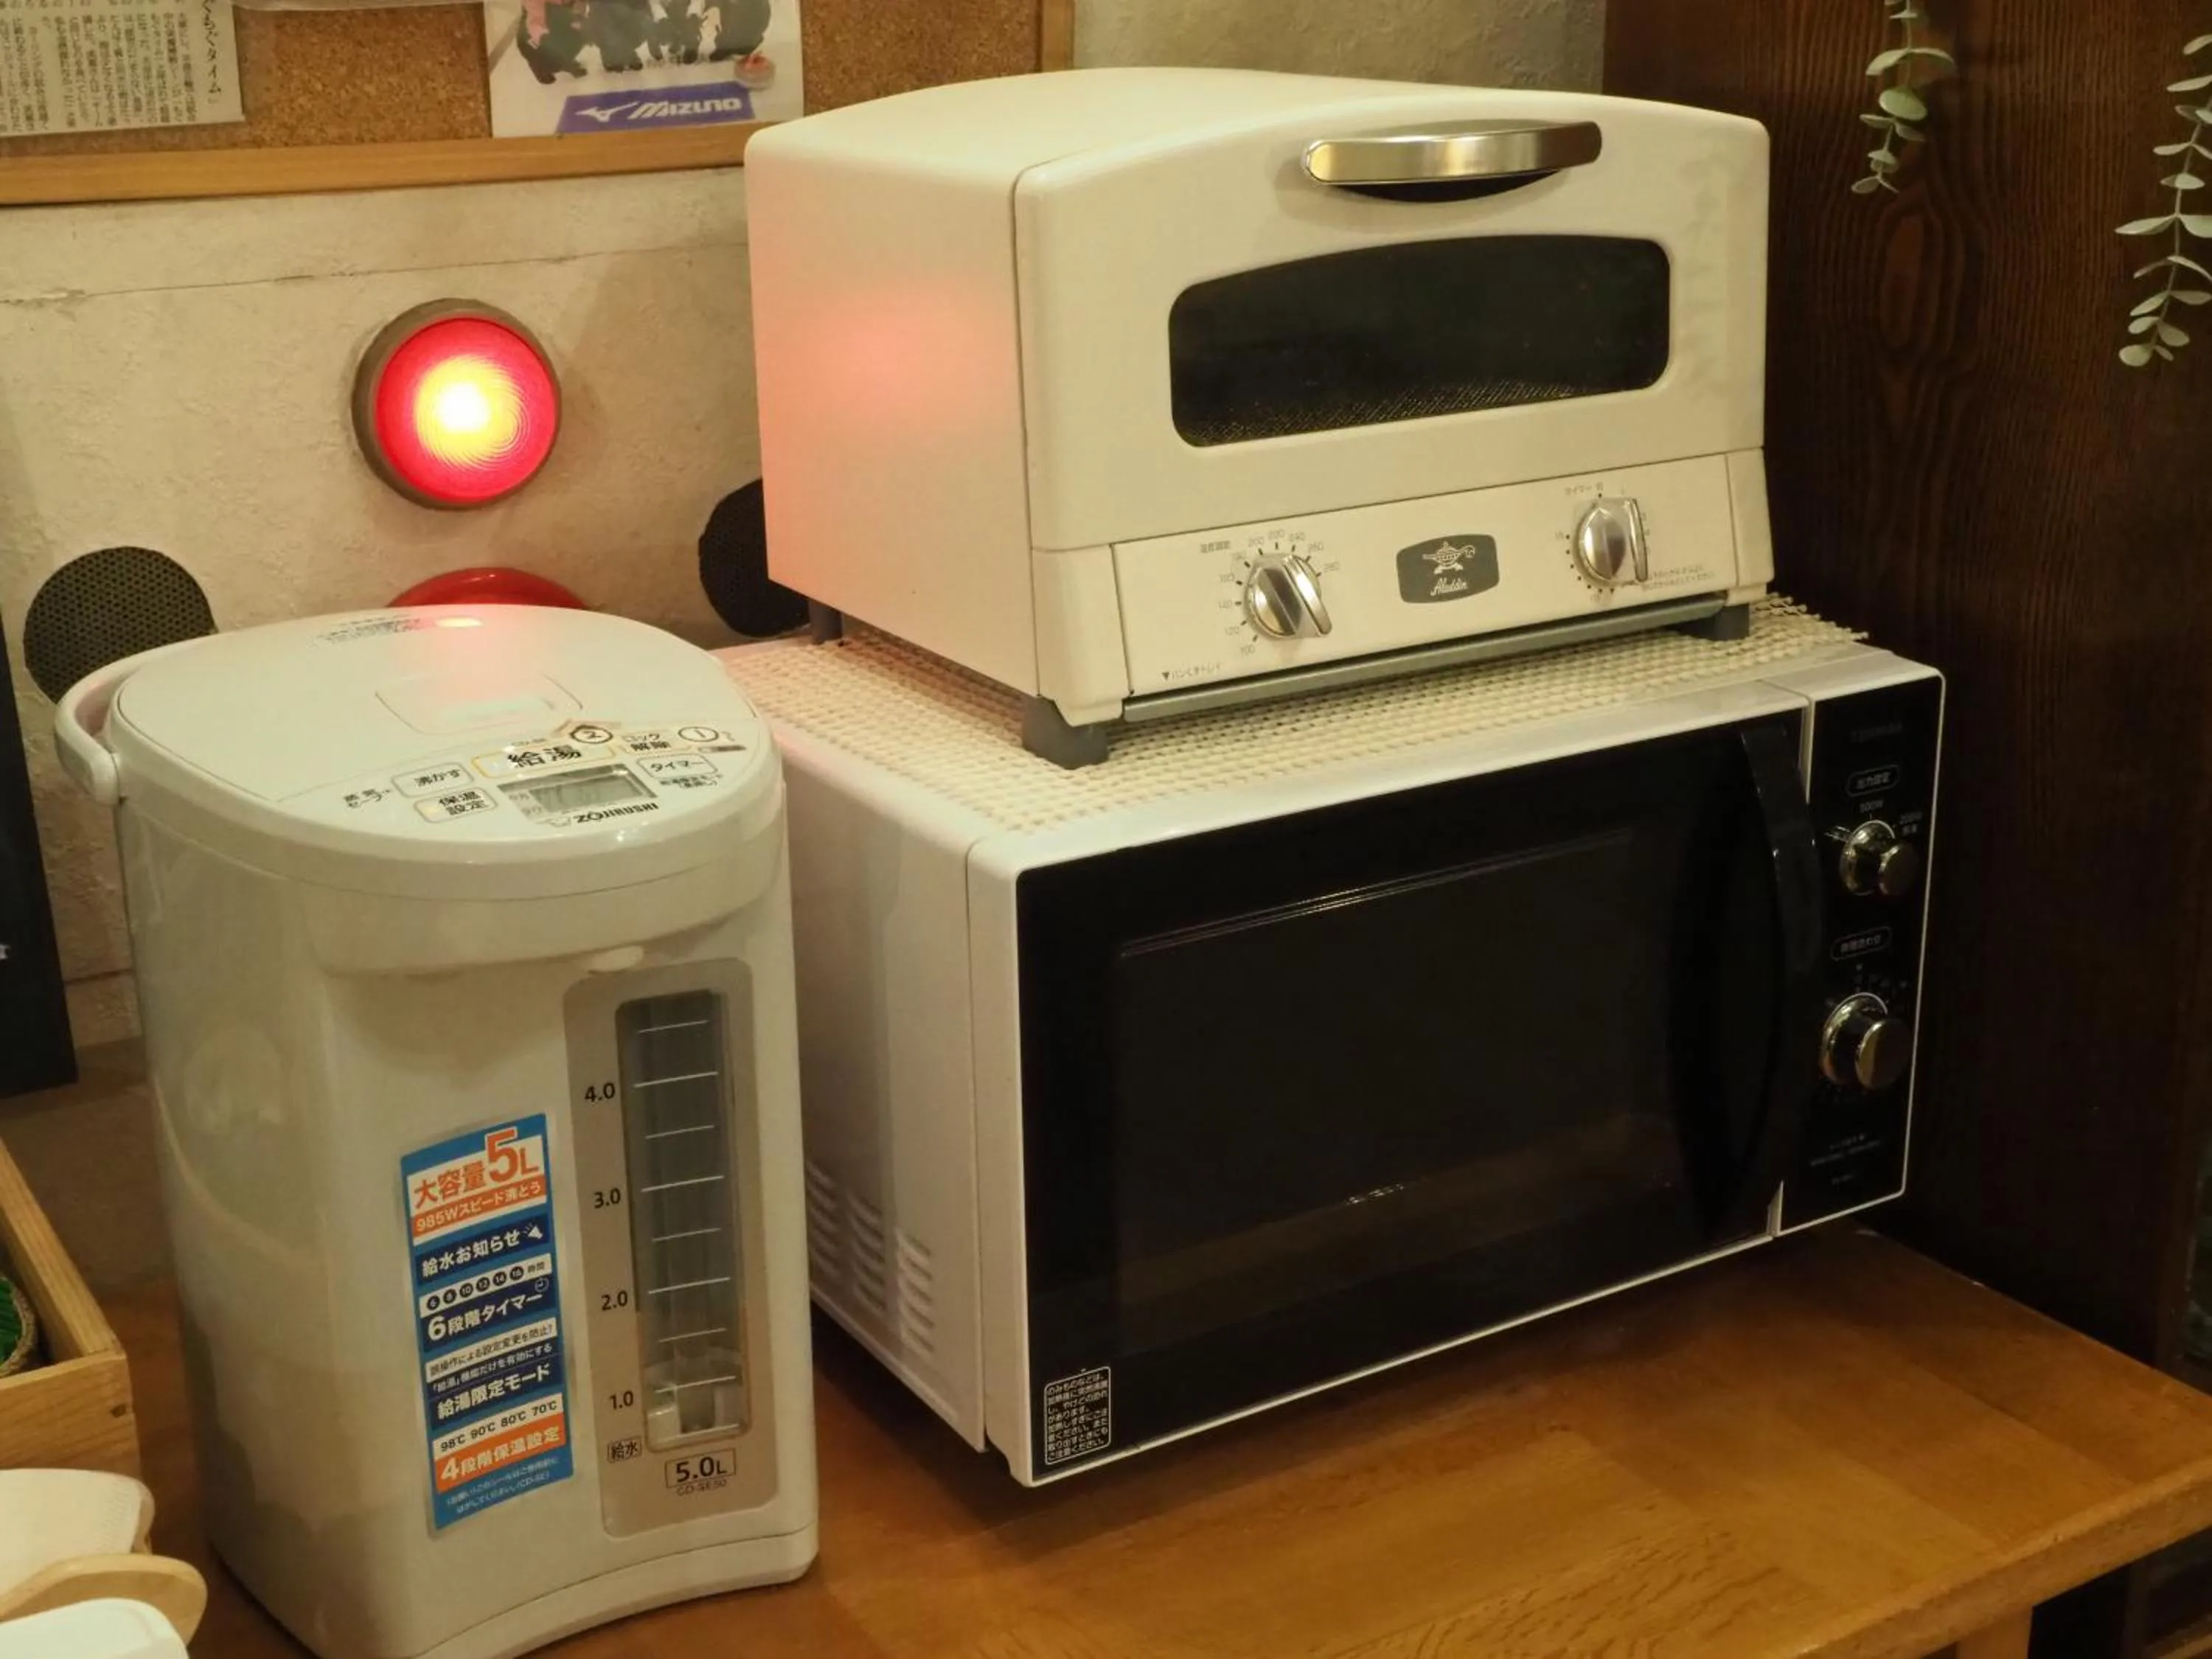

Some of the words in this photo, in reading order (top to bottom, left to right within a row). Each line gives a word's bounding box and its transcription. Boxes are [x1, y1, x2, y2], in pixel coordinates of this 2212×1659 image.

[507, 744, 582, 768] 給湯
[650, 759, 705, 772] タイマー
[572, 802, 659, 824] ZOJIRUSHI
[585, 1082, 616, 1102] 4.0
[594, 1187, 621, 1209] 3.0
[422, 1228, 521, 1278] 給水お知らせ
[601, 1290, 628, 1312] 2.0
[428, 1293, 543, 1341] 6段階タイマー
[437, 1363, 551, 1420] 給湯限定モード
[609, 1391, 634, 1410] 1.0
[441, 1426, 560, 1481] 4段階保温設定
[611, 1441, 639, 1461] 給水
[675, 1456, 728, 1483] 5.0L
